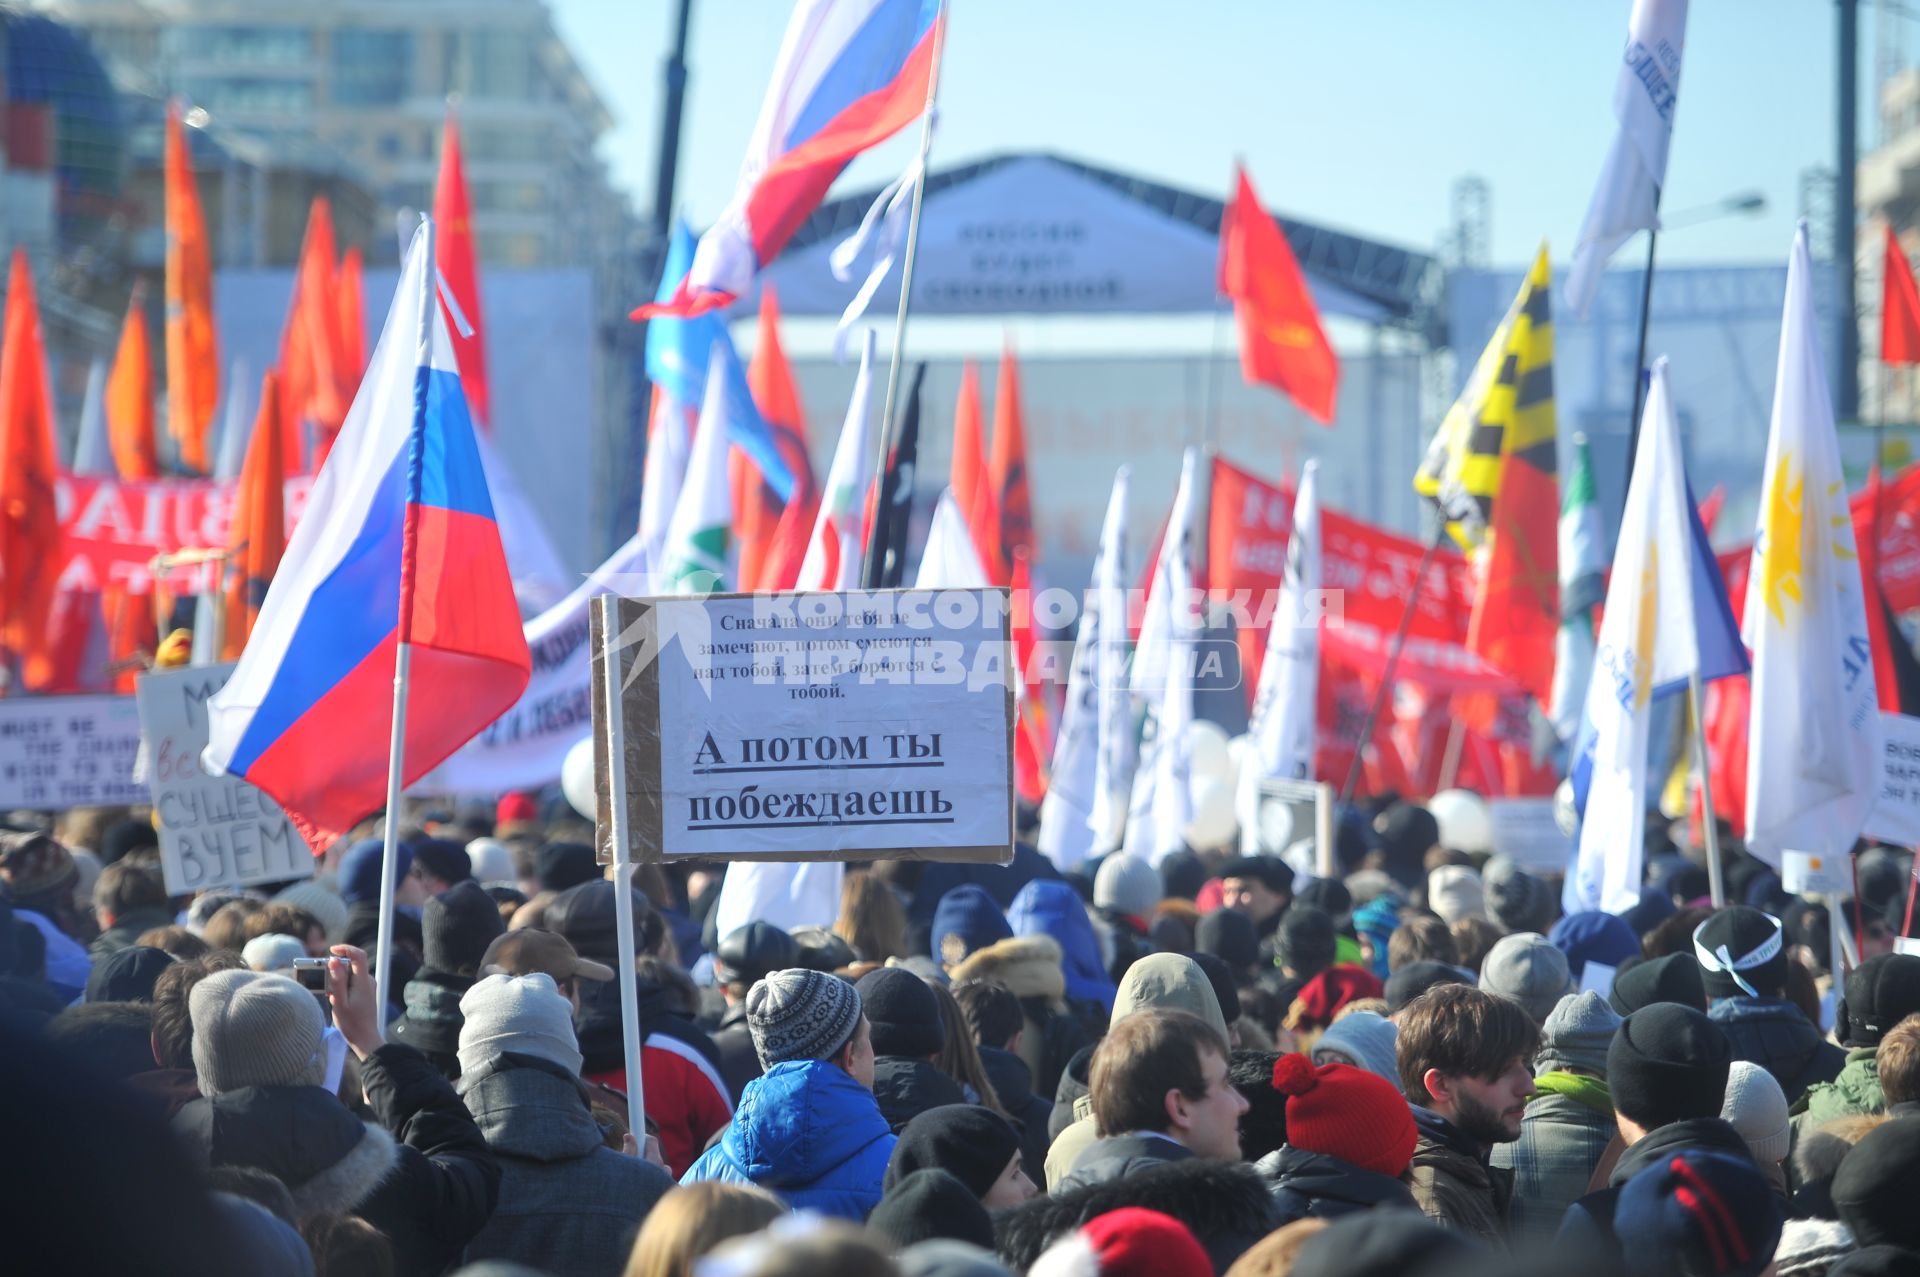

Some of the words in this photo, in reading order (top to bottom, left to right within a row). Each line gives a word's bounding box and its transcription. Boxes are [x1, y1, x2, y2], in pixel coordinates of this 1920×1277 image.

[720, 615, 800, 630] Сначала
[805, 614, 838, 628] они
[843, 609, 883, 626] тебя
[889, 611, 910, 625] не
[698, 640, 790, 655] замечают,
[795, 639, 849, 652] потом
[856, 636, 932, 649] смеются
[693, 667, 725, 680] над
[730, 661, 787, 678] тобой,
[792, 663, 842, 676] затем
[849, 659, 925, 678] борются
[930, 660, 941, 672] с
[183, 678, 230, 728] М
[788, 683, 845, 700] тобой.
[158, 736, 204, 782] вс
[694, 730, 725, 766] А
[741, 735, 868, 763] потом
[883, 733, 942, 758] ты
[688, 785, 953, 822] побеждаешь
[178, 820, 295, 887] ВУЕМ
